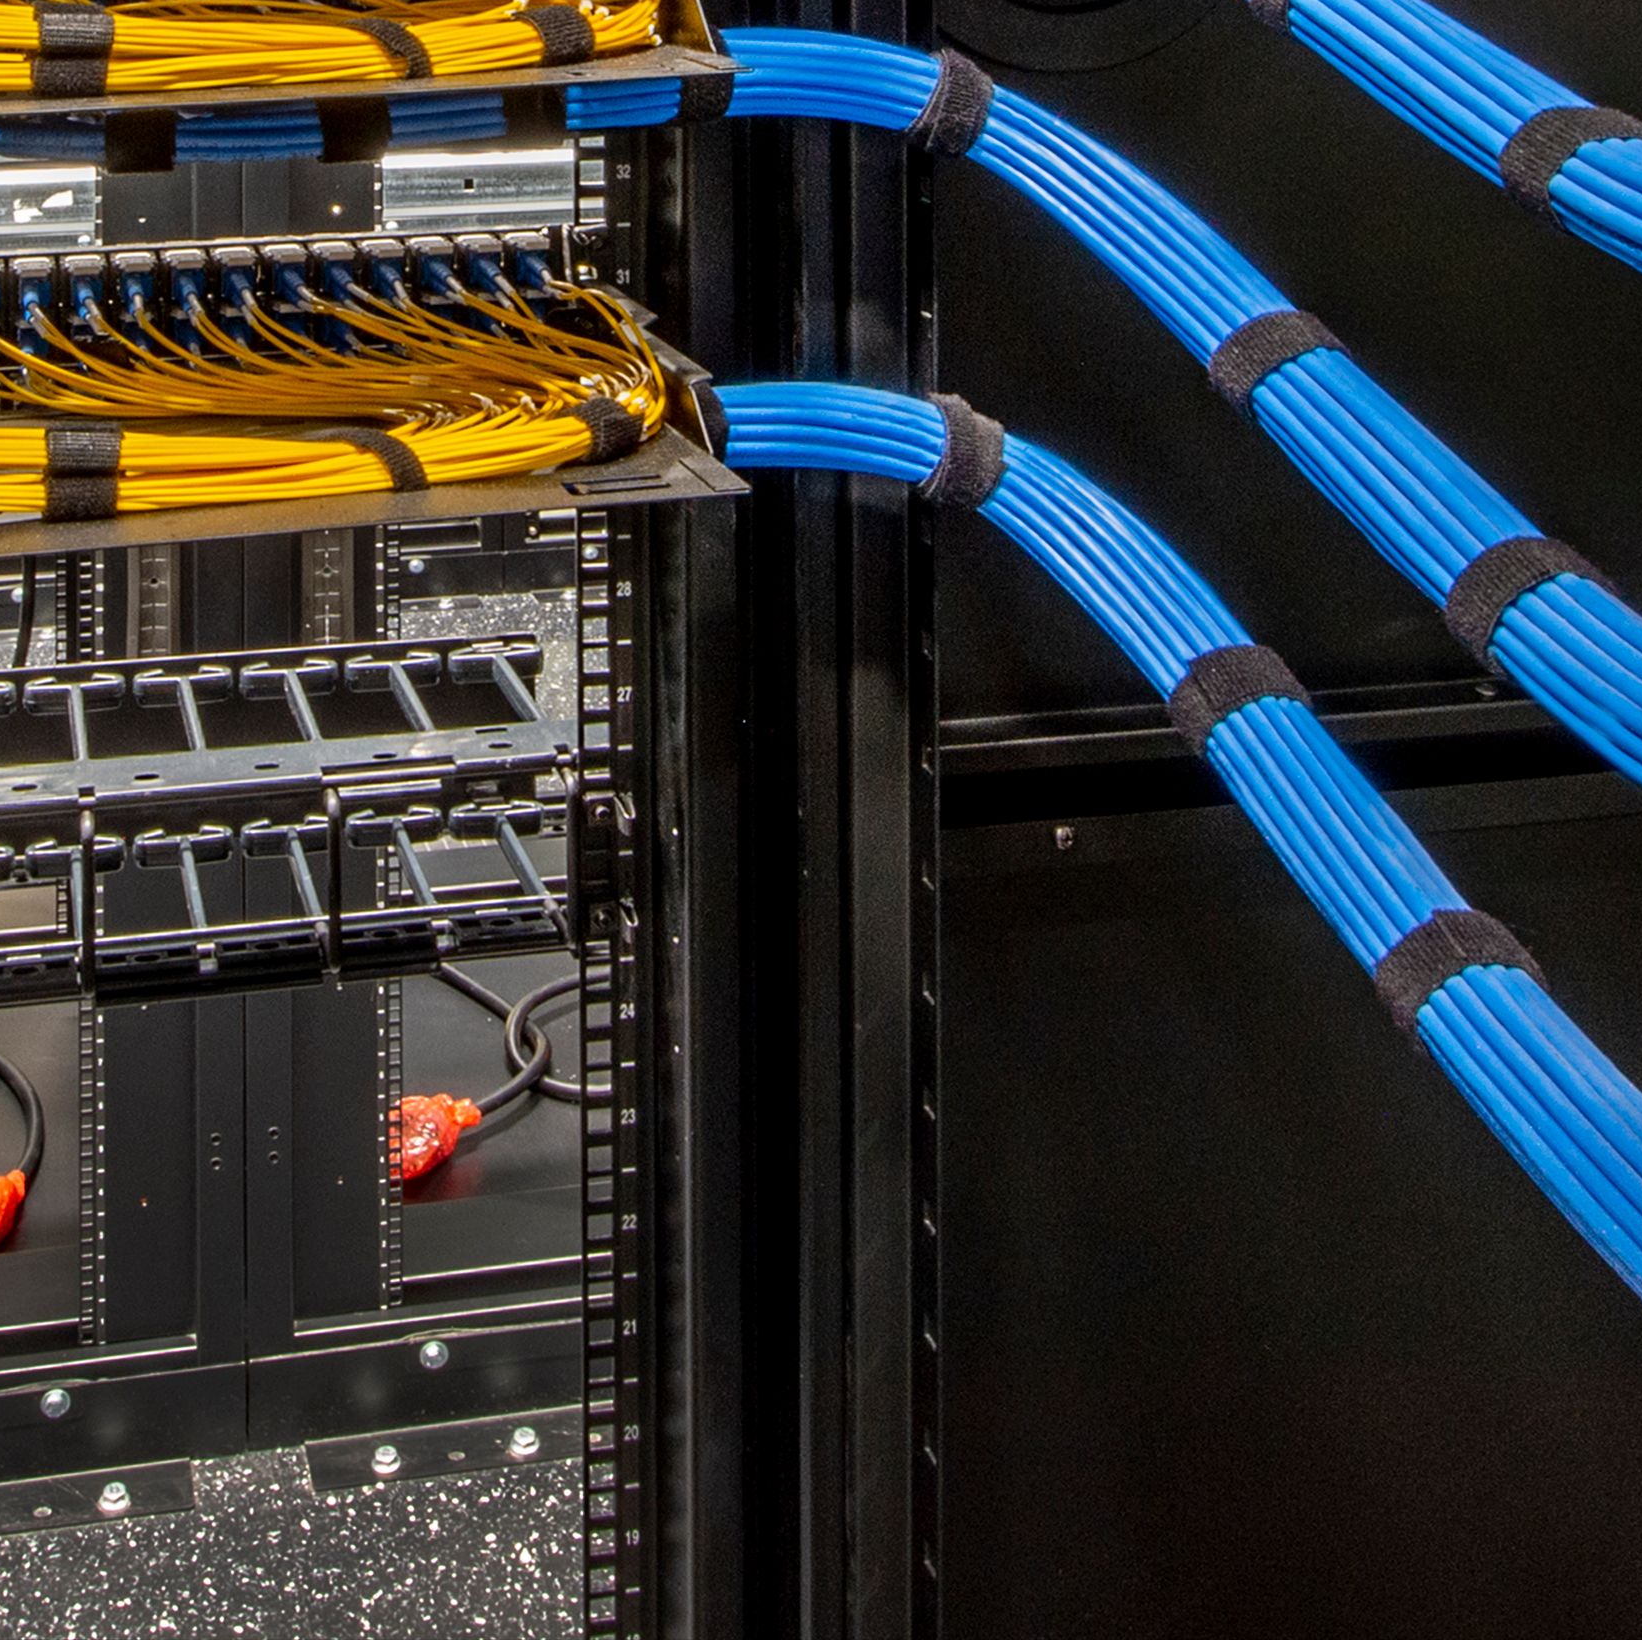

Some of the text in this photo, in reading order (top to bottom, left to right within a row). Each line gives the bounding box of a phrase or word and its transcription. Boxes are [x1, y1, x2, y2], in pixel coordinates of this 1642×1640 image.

[615, 163, 630, 179] 32
[616, 269, 630, 284] 31
[616, 581, 632, 597] 28
[617, 686, 632, 702] 27
[619, 1002, 635, 1019] 24
[620, 1108, 636, 1125] 23
[621, 1213, 637, 1230] 22
[622, 1318, 636, 1335] 21
[623, 1424, 639, 1441] 20
[625, 1529, 640, 1545] 19
